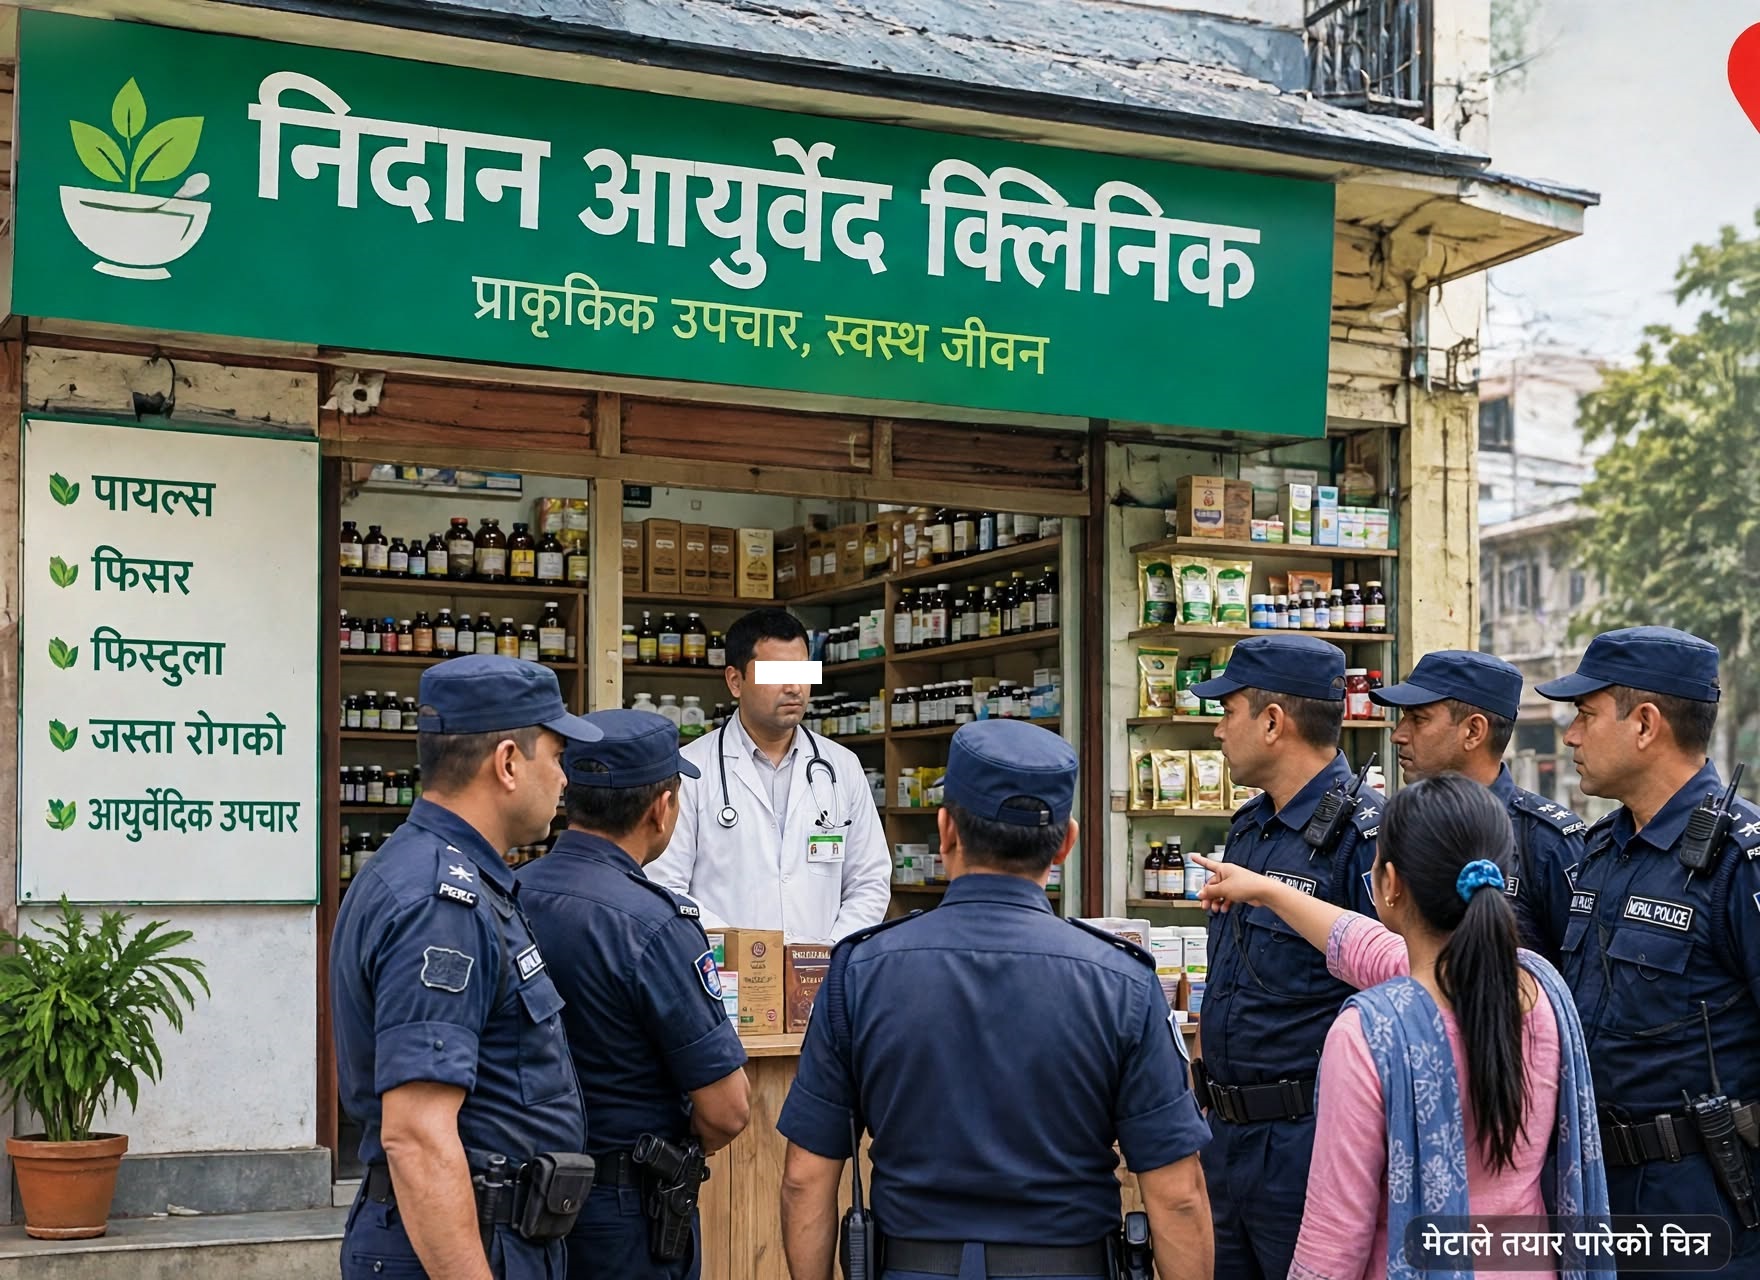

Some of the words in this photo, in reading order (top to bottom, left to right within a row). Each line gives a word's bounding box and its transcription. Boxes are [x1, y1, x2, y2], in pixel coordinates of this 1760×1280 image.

[248, 71, 551, 230] निदान
[578, 138, 893, 289] आयुर्वेद
[671, 298, 811, 358] उपचार,
[825, 314, 930, 363] स्वस्थ
[941, 316, 1050, 375] जीवन
[91, 475, 217, 517] पायल्स
[91, 545, 194, 596] फिसर
[89, 718, 176, 754] जस्ता
[184, 710, 287, 756] रोगको
[88, 787, 214, 843] आयुर्वेदिक
[219, 800, 301, 834] उपचार
